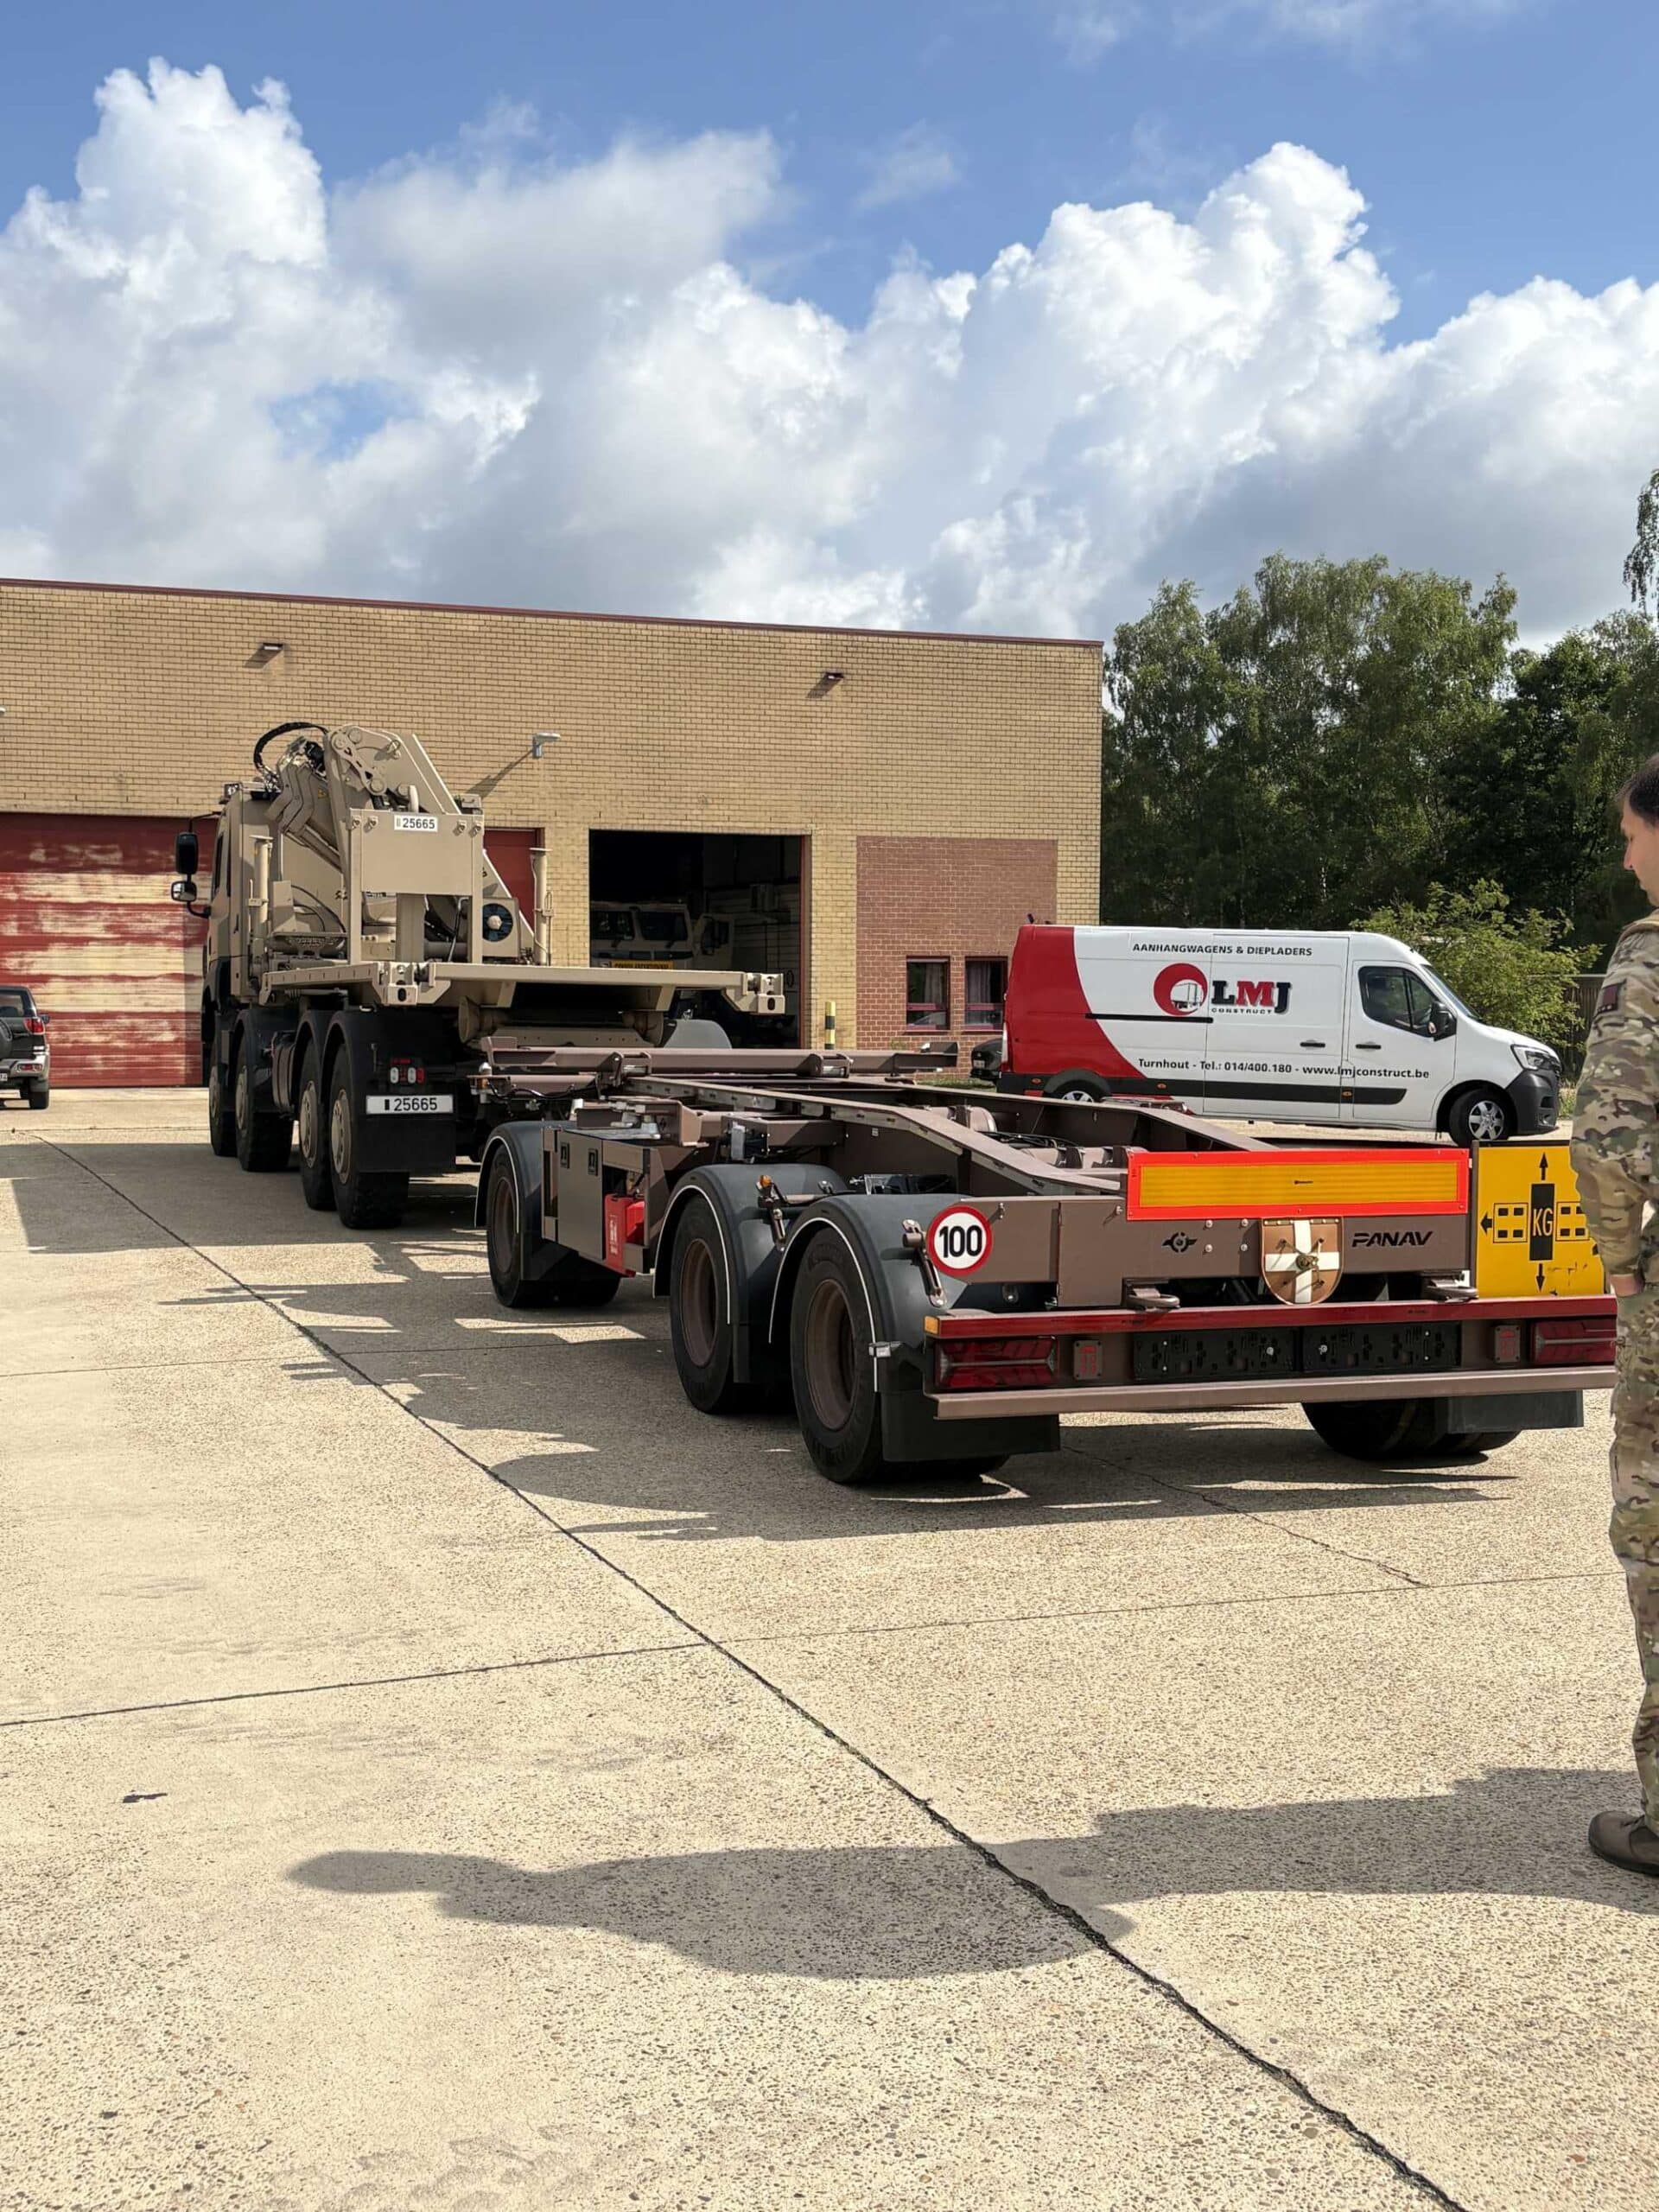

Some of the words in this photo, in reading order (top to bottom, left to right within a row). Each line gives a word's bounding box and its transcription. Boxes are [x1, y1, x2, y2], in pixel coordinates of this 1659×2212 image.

[403, 817, 435, 830] 25665
[1133, 943, 1233, 954] AANHANGWAGENS
[1236, 945, 1244, 954] &
[1247, 945, 1313, 957] DIEPLADERS
[1211, 980, 1292, 1014] LMJ
[1138, 1058, 1189, 1070] Turnhout
[1224, 1061, 1293, 1073] 014/400.180
[1302, 1065, 1429, 1078] www.lmjconstruct.be
[394, 1096, 438, 1112] 25665
[1532, 1208, 1554, 1236] KG
[938, 1224, 982, 1258] 100
[1351, 1230, 1433, 1248] PANAV
